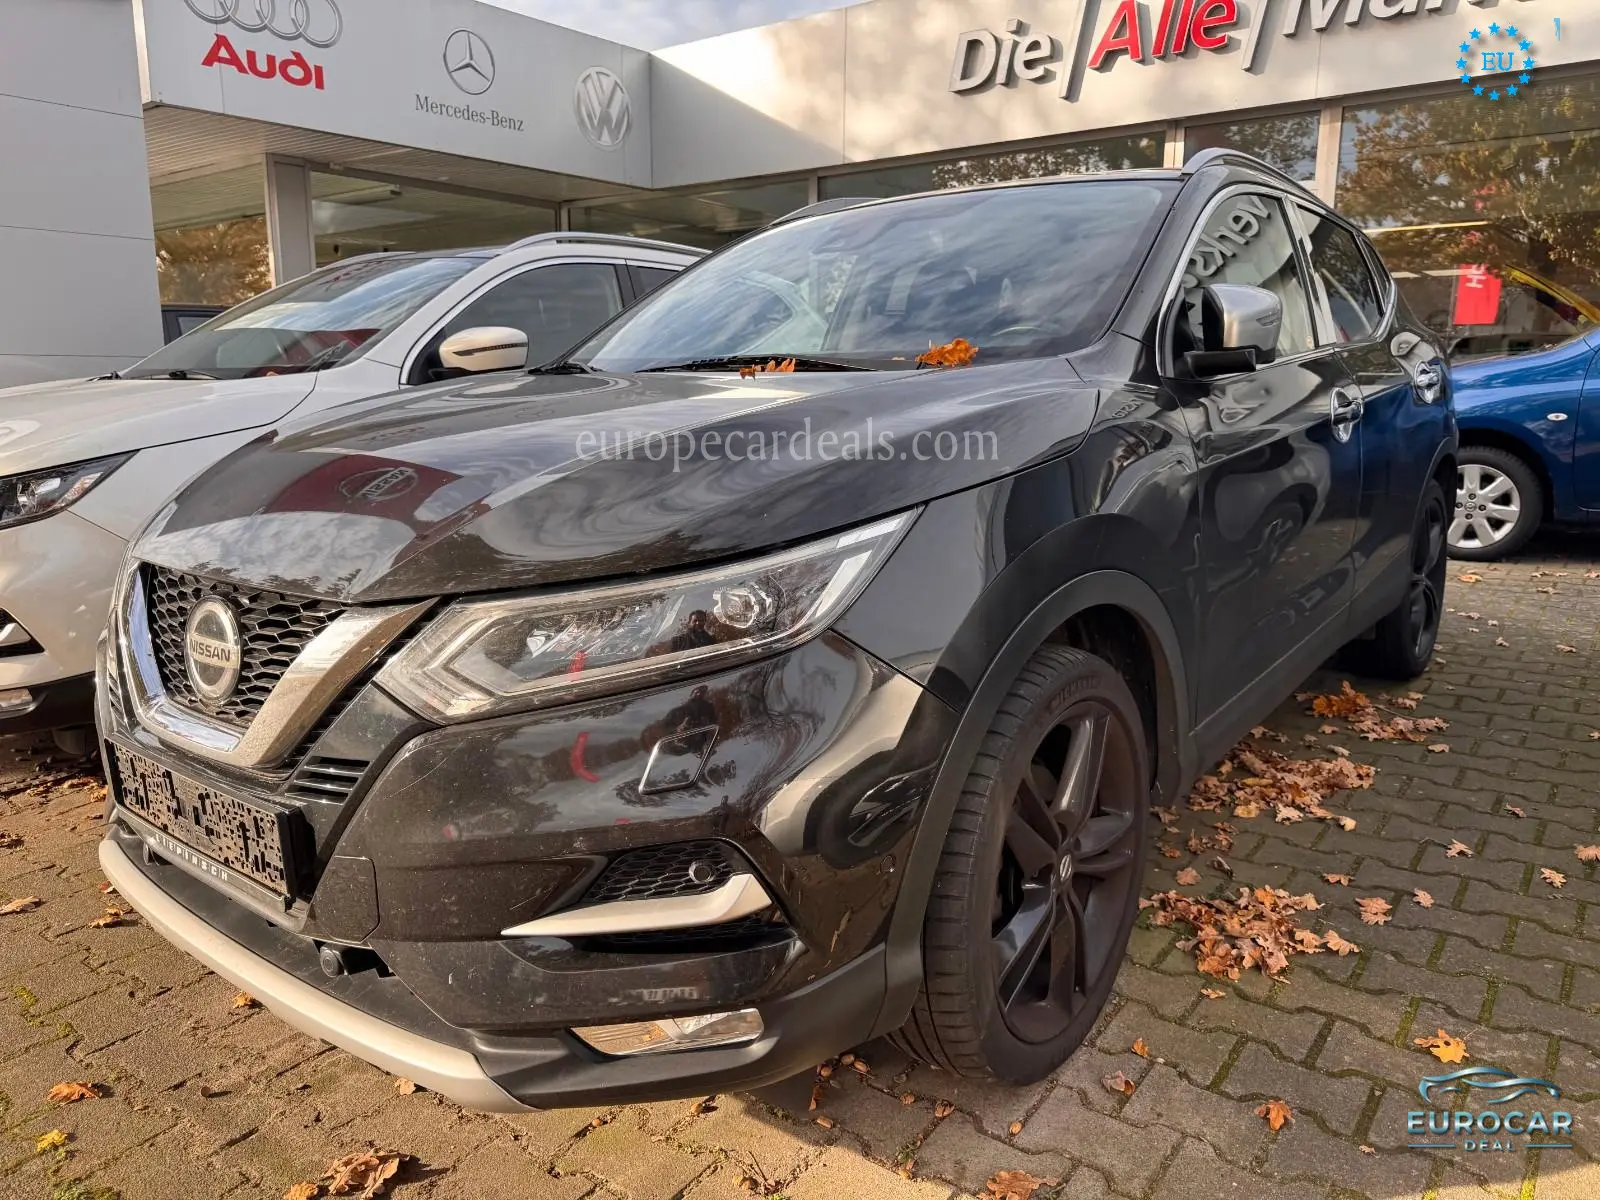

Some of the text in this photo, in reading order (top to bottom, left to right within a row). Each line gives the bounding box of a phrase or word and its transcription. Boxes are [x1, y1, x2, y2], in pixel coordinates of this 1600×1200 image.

[201, 33, 325, 90] Audi
[948, 18, 1061, 96] Die
[1088, 0, 1240, 72] Alle
[414, 93, 525, 133] Mercedes-Benz
[190, 638, 231, 663] NISSAN
